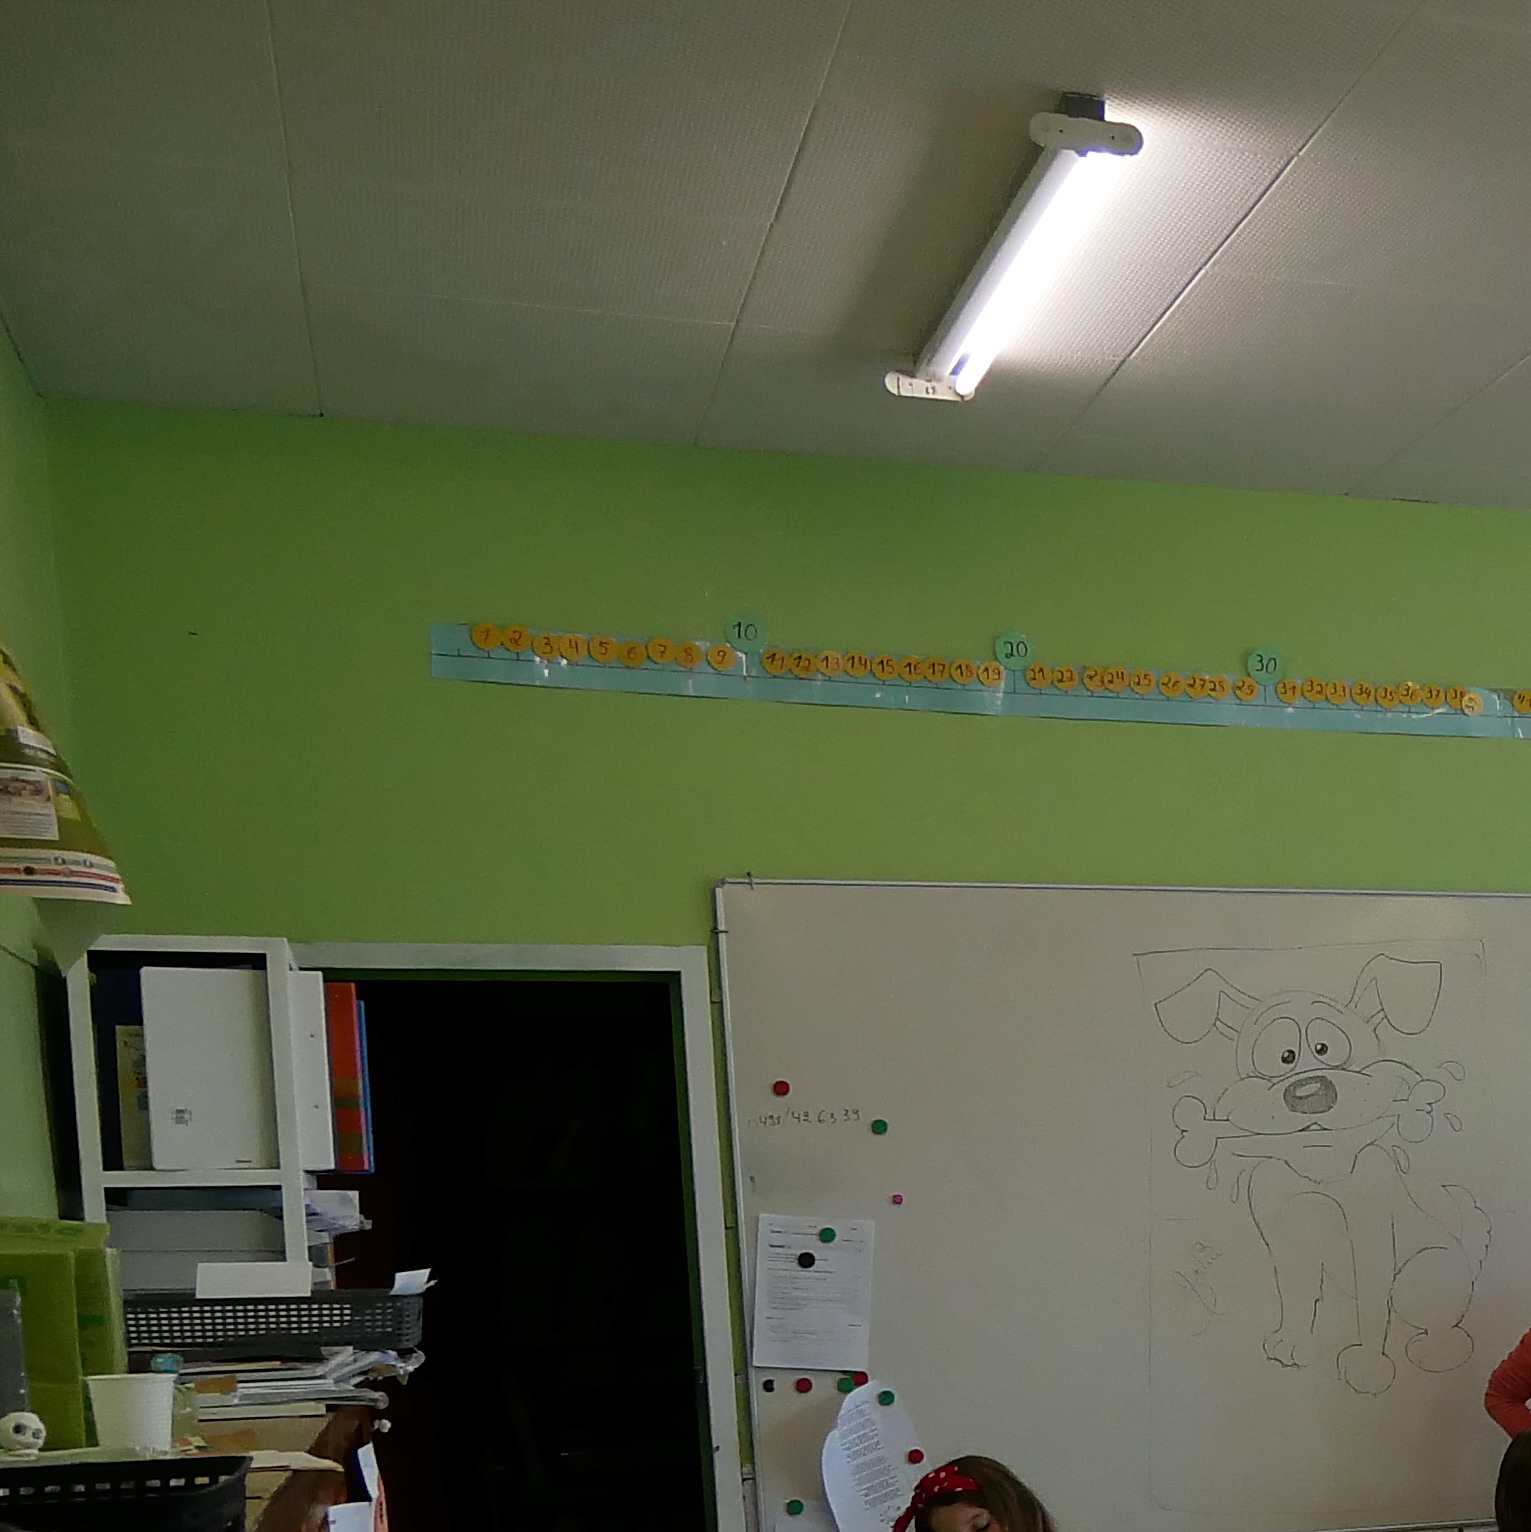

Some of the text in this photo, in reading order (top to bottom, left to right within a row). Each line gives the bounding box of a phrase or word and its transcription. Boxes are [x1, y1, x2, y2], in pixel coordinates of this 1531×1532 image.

[480, 628, 490, 642] 1
[510, 630, 522, 645] 2
[542, 636, 553, 654] 3
[568, 638, 579, 654] 4
[599, 641, 610, 655] 5
[627, 646, 636, 659] 6
[657, 644, 667, 658] 7
[684, 647, 693, 663] 8
[717, 650, 726, 664] 9
[732, 622, 758, 641] 10
[766, 653, 785, 670] 11
[793, 653, 811, 672] 12
[821, 655, 840, 670] 13
[847, 655, 868, 670] 14
[877, 659, 895, 674] 15
[904, 661, 920, 675] 16
[929, 662, 946, 677] 17
[955, 663, 972, 677] 18
[982, 666, 1001, 681] 19
[1003, 641, 1028, 659] 20
[1029, 669, 1045, 681] 21
[1057, 669, 1074, 683] 22
[1107, 670, 1124, 684] 24
[1133, 674, 1151, 687] 25
[1186, 678, 1206, 691] 27
[1236, 682, 1254, 695] 29
[1255, 655, 1277, 673] 30
[1281, 684, 1296, 695] 31
[1307, 680, 1324, 695] 32
[1356, 685, 1371, 699] 34
[1380, 687, 1396, 701] 35
[1401, 685, 1418, 699] 36
[1426, 688, 1440, 699] 37
[1452, 689, 1464, 700] 38
[1464, 697, 1478, 712] 39
